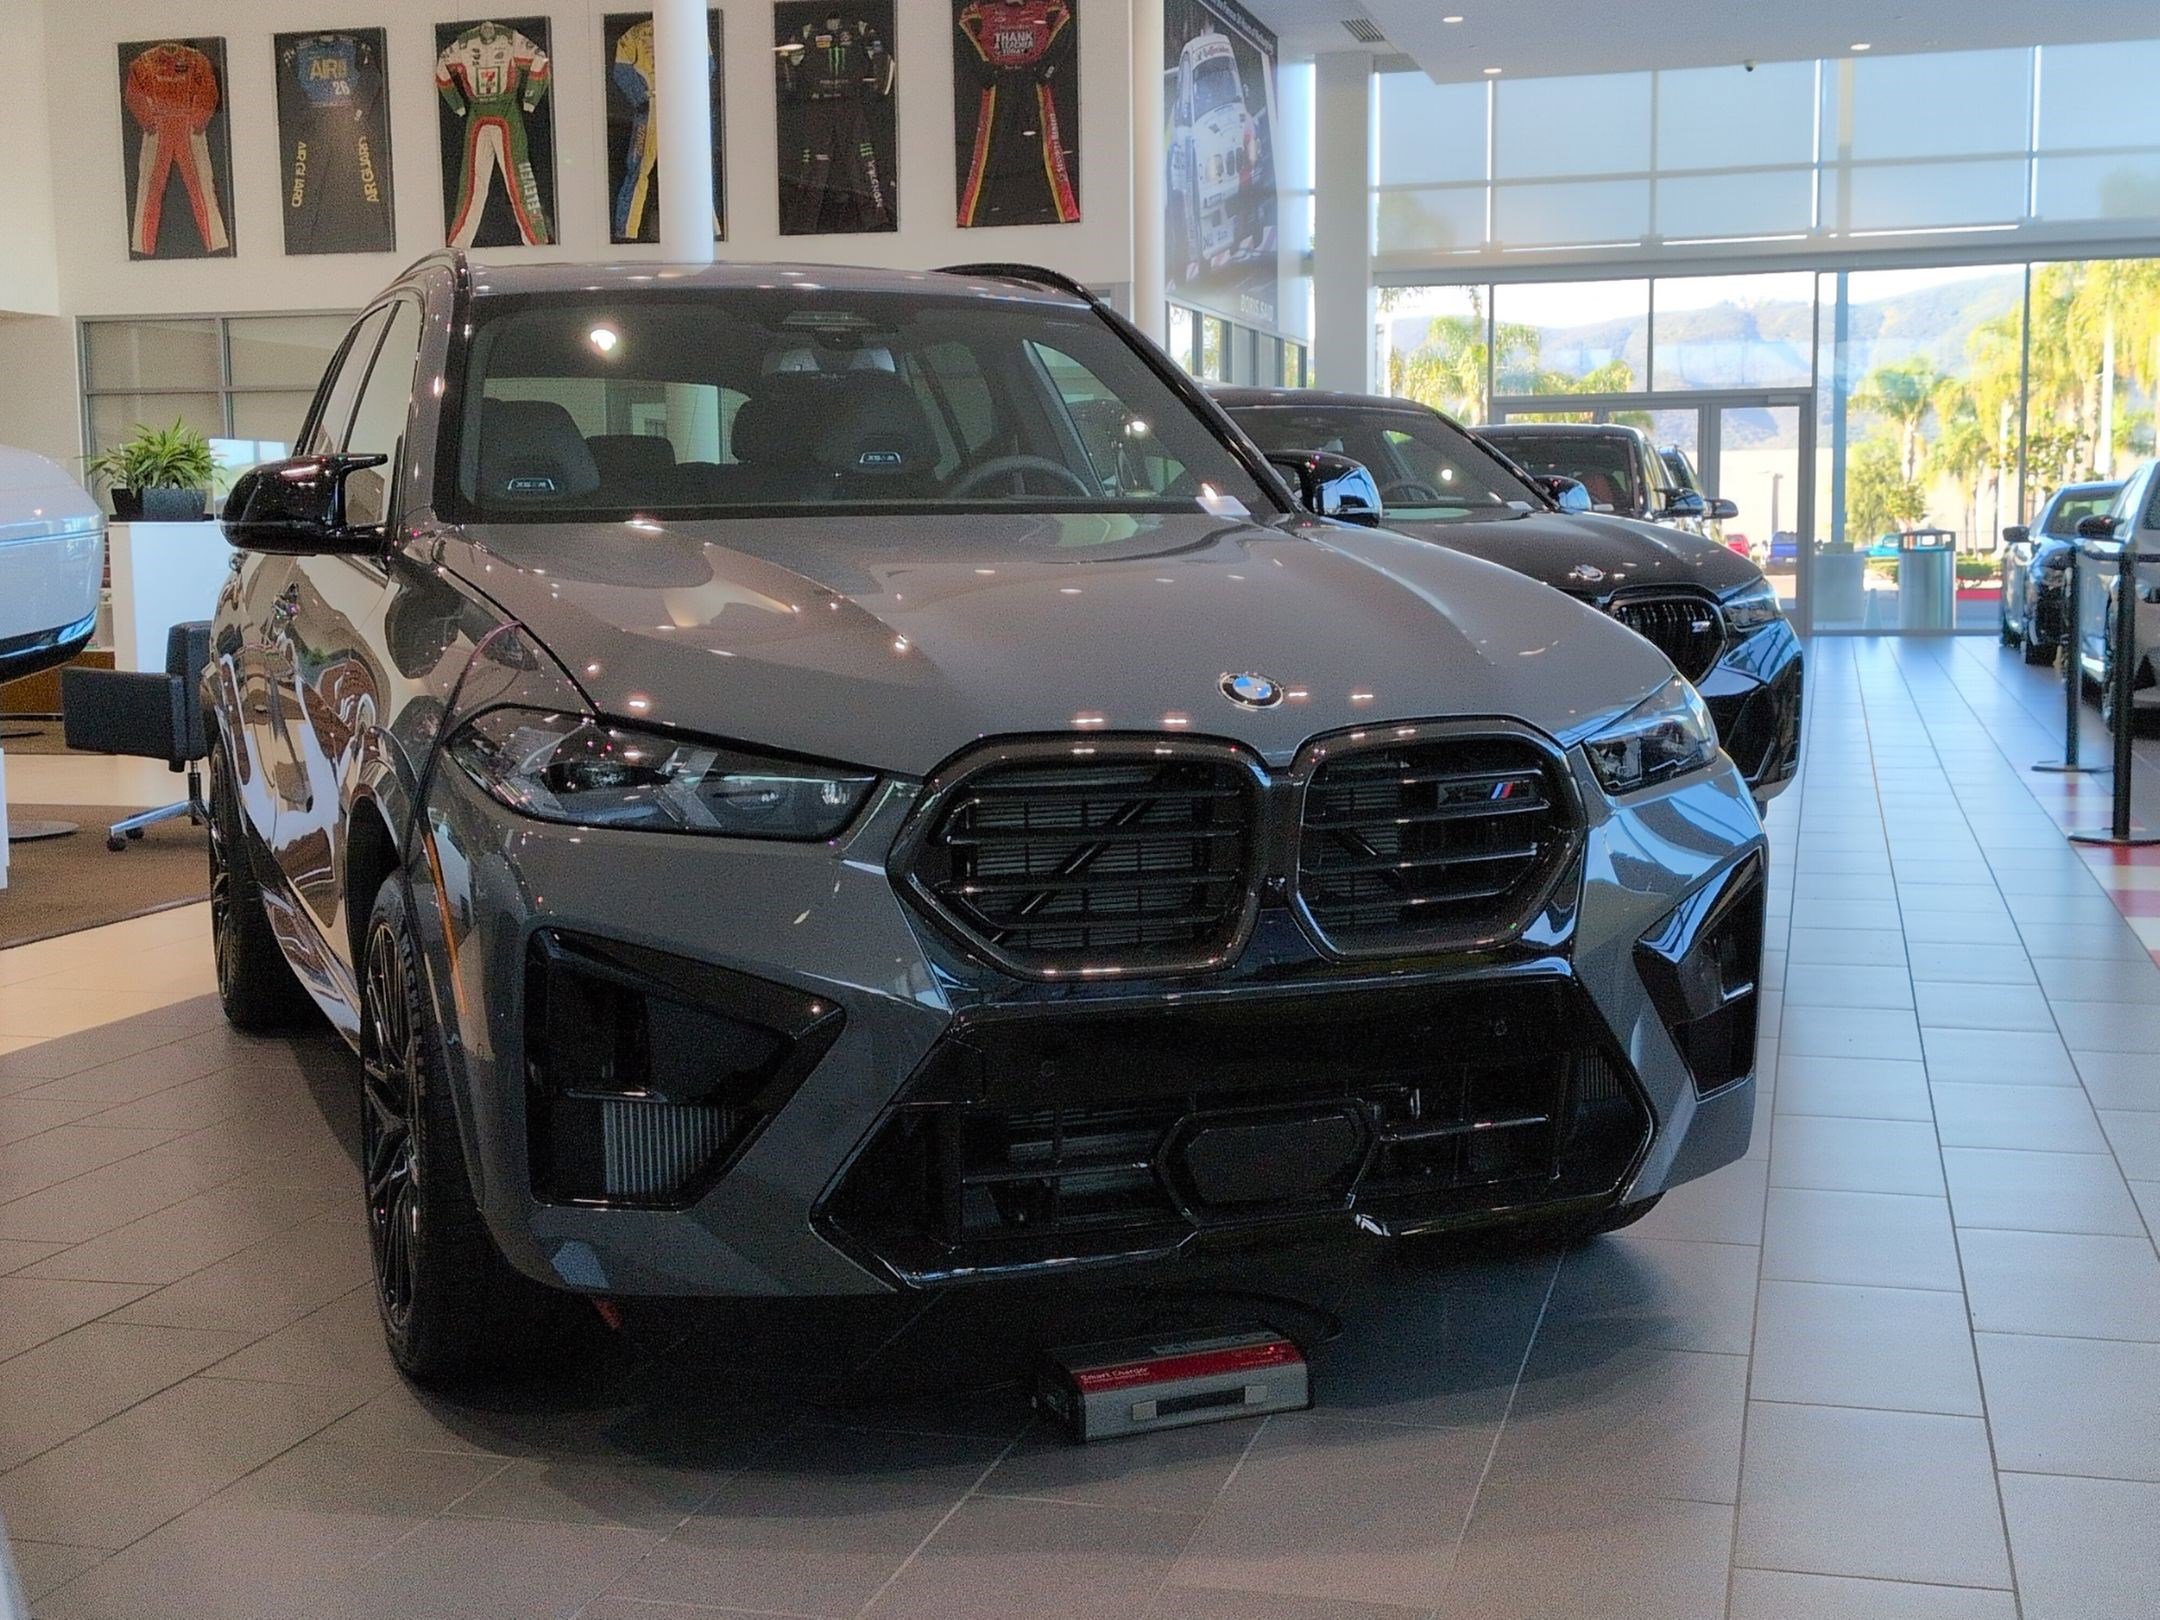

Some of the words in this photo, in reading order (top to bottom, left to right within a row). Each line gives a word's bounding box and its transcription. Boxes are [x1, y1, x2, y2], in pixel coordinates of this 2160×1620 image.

[995, 31, 1034, 42] THANK
[1080, 1371, 1111, 1380] Smart
[1111, 1367, 1150, 1378] Charger
